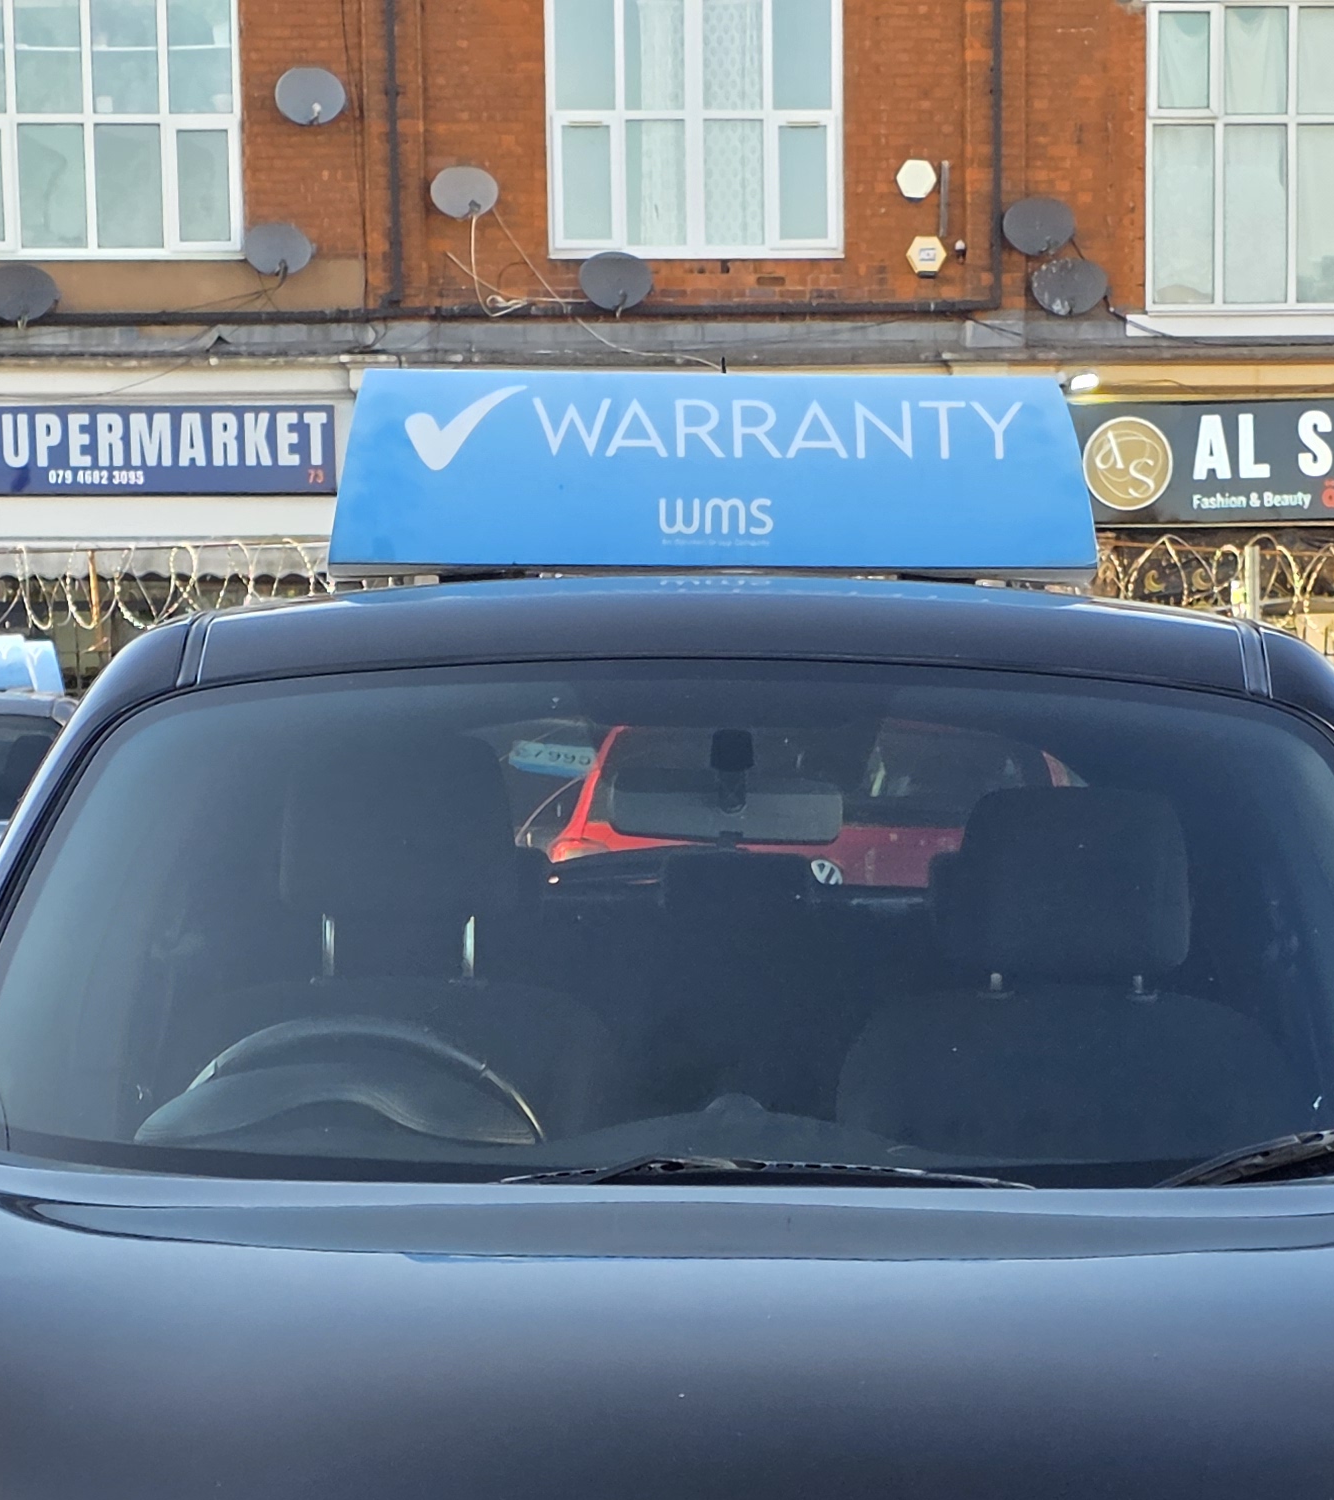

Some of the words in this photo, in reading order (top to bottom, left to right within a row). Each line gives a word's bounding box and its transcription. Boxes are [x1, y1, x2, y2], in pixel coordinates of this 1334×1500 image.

[531, 397, 1025, 461] WARRANTY
[1192, 412, 1271, 481] AL
[48, 469, 72, 484] 079
[658, 497, 774, 535] wms
[1192, 494, 1247, 509] Fashion
[1249, 491, 1261, 507] &
[1262, 491, 1312, 509] Beauty
